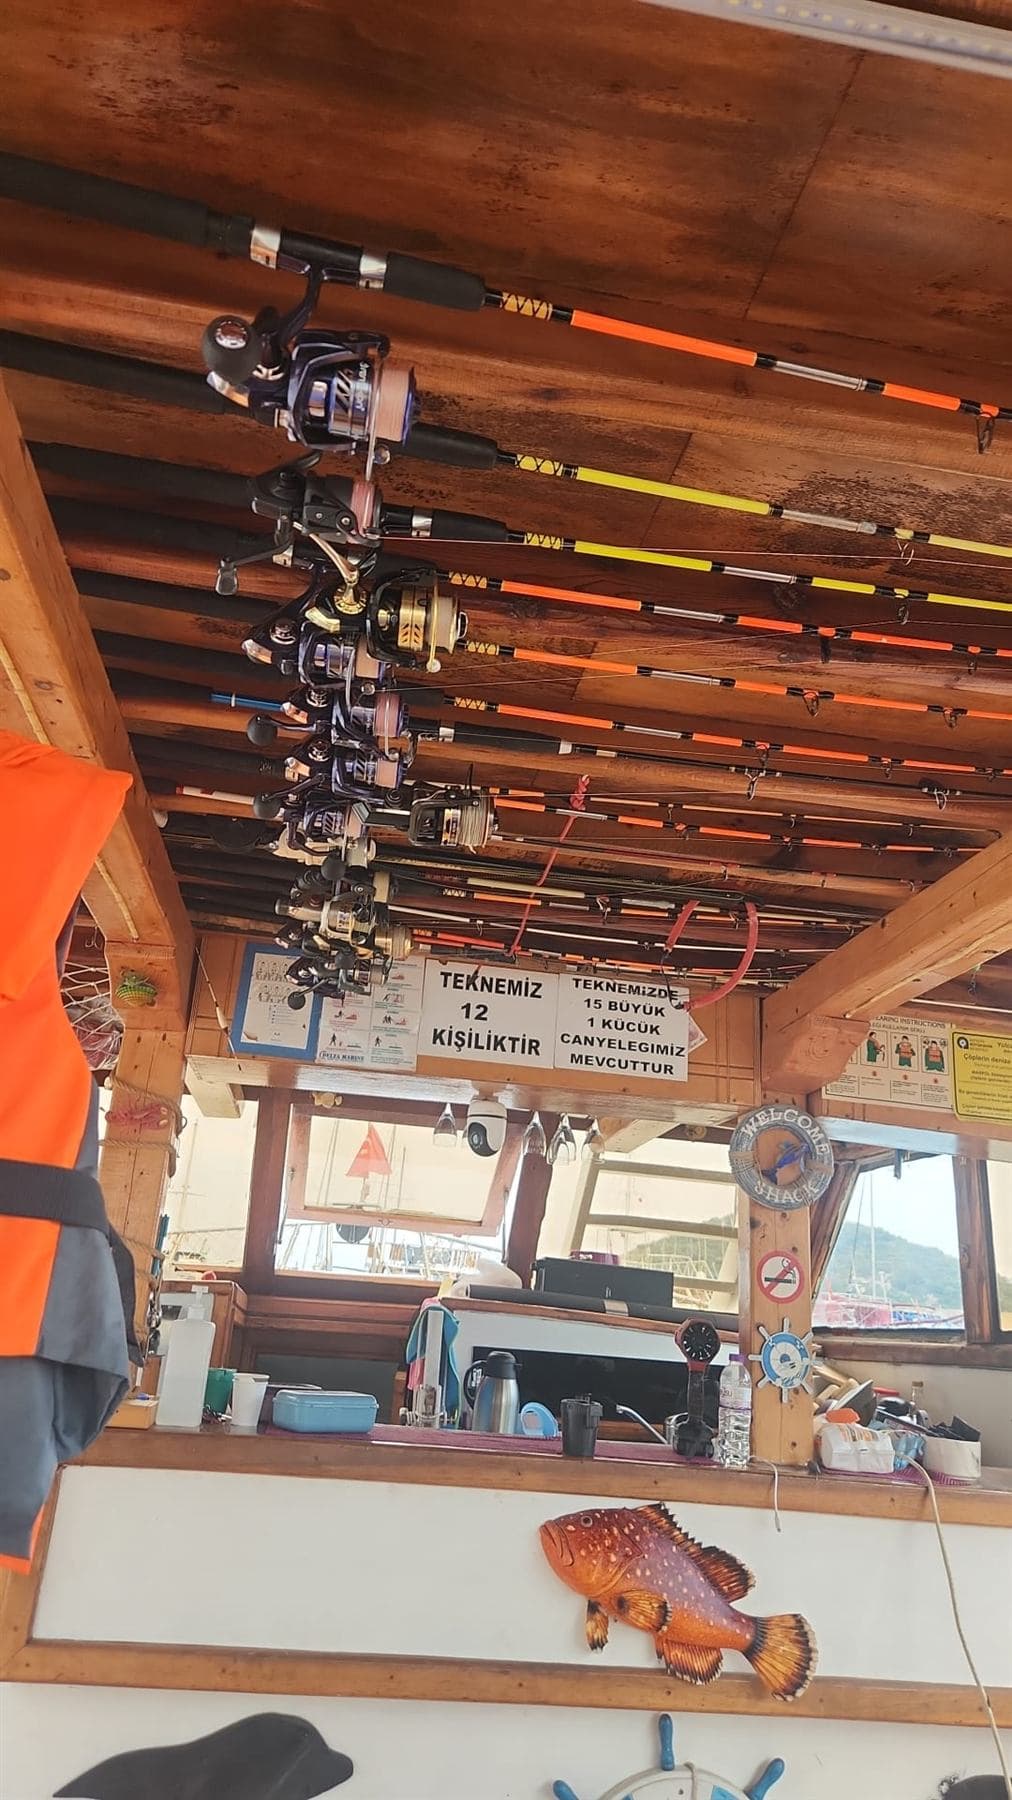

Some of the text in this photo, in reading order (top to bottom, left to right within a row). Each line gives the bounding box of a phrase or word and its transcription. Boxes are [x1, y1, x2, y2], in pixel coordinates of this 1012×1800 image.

[440, 971, 543, 999] TEKNEMİZ
[460, 1002, 489, 1021] 12
[584, 998, 665, 1017] 15 BÜYÜK
[587, 1017, 661, 1035] 1 KÜCÜK
[432, 1025, 541, 1056] KİŞİLİKTİR
[560, 1033, 686, 1057] CANYELEGIMİZ
[570, 1053, 674, 1075] MEVCUTTUR
[740, 1108, 830, 1155] WELCOME
